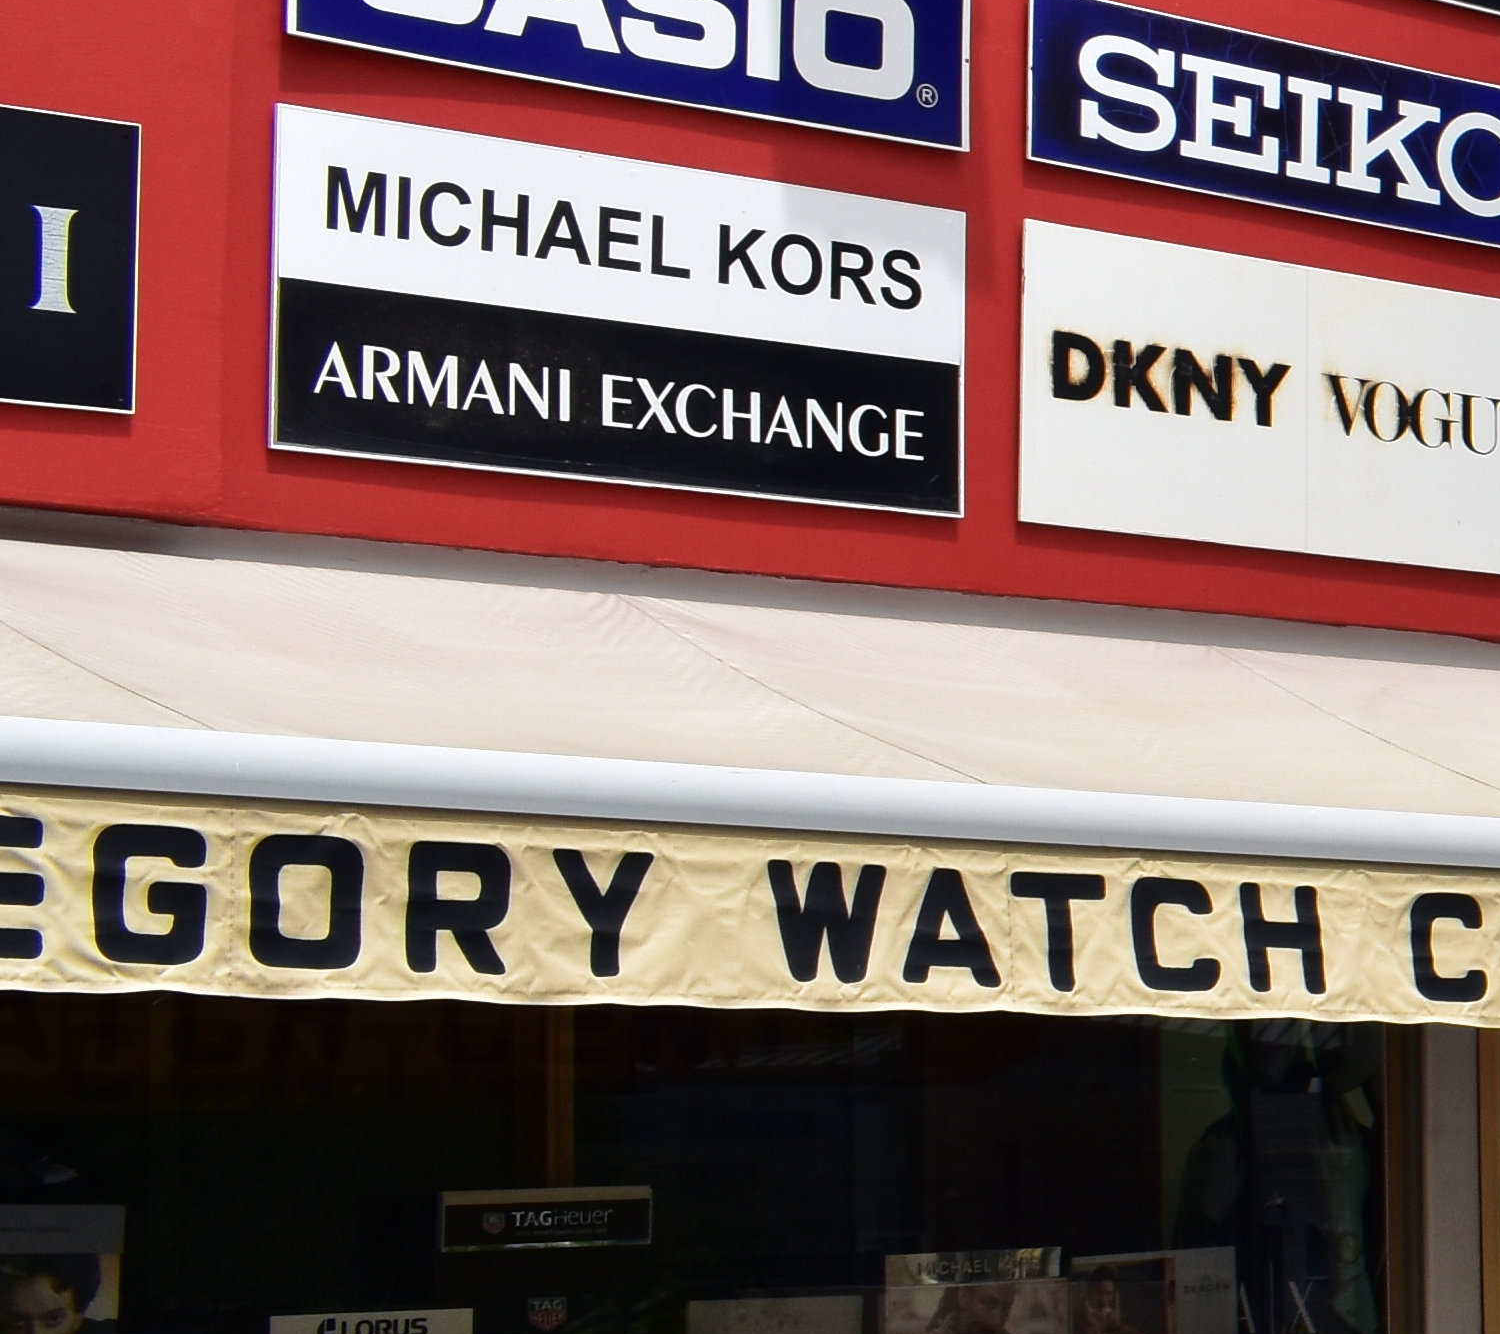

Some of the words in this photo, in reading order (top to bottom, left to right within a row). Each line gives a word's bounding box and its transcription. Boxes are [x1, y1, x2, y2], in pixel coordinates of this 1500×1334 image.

[326, 164, 691, 280] MICHAEL
[716, 223, 922, 311] KORS
[313, 340, 571, 422] ARMANI
[601, 377, 926, 463] EXCHANGE
[1051, 330, 1291, 428] DKNY
[767, 858, 1327, 996] WATCH
[531, 1300, 563, 1310] TAG
